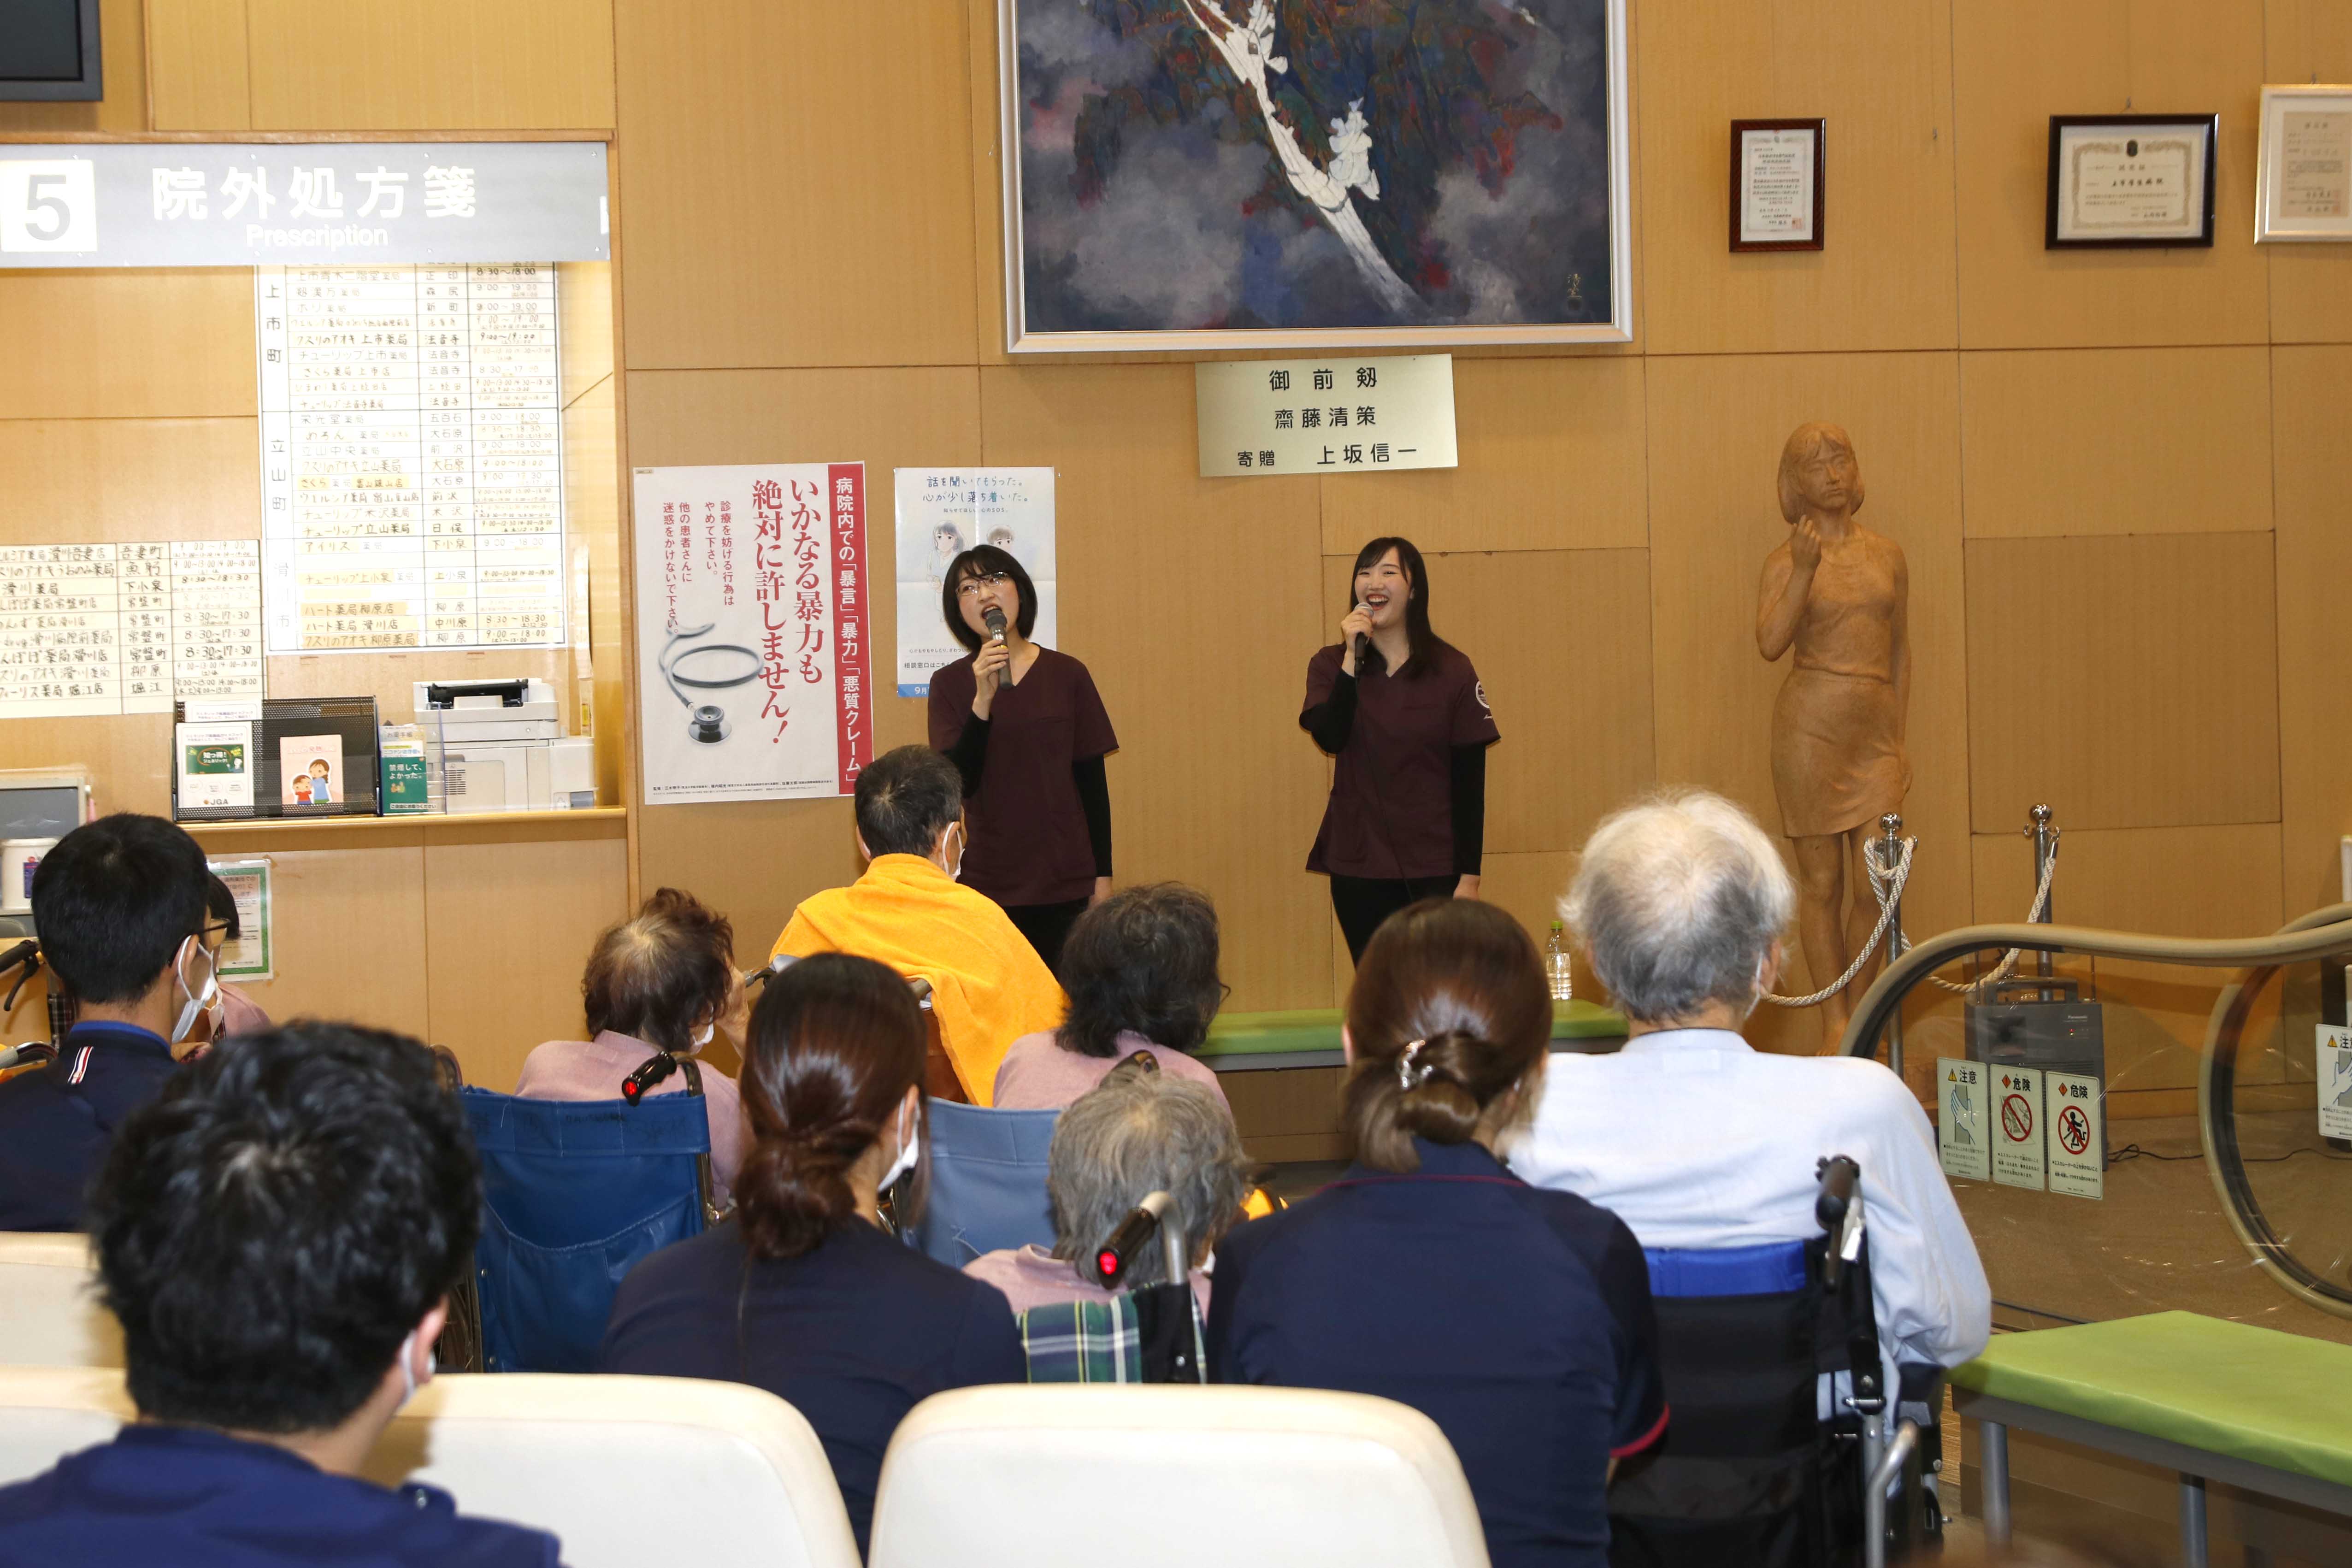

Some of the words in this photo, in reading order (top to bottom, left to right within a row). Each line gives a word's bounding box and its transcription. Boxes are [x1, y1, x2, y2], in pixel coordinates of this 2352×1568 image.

[152, 165, 477, 220] 院外処方箋
[25, 175, 71, 241] 5
[246, 224, 389, 251] Prescription
[265, 283, 283, 363] 上市町
[424, 333, 460, 345] 法音寺
[427, 350, 460, 360] 法音寺
[427, 365, 460, 375] 法音寺
[430, 397, 460, 407] 法音寺
[430, 413, 461, 423] 五百石
[430, 429, 462, 439] 大石原
[430, 444, 463, 454] 前沢
[1238, 450, 1275, 467] 寄贈
[1317, 443, 1417, 465] 上坂信一
[432, 458, 465, 471] 大石原
[270, 439, 288, 511] 立山町
[432, 476, 464, 486] 大石原
[926, 476, 1023, 488] 話を聞いてもらった。
[923, 491, 1029, 504] 心が少し落ち着いた。
[431, 538, 466, 550] 下小泉
[679, 502, 693, 584] 他の患者さんに
[704, 501, 719, 576] やめて下さい。
[122, 544, 164, 560] 吾妻町
[720, 501, 734, 607] 診療を妨げる行為は
[435, 570, 466, 580] 上小泉
[663, 502, 679, 634] 迷惑をかけないで下さい。
[124, 579, 164, 592] 下小泉
[790, 479, 824, 684] いかなる暴力も
[1, 582, 59, 597] 滑川薬局
[435, 601, 465, 613] 柳原
[435, 617, 468, 629] 中川原
[836, 477, 861, 782] 病院内での「暴言」「暴力」「悪質クレーム」
[436, 631, 466, 643] 柳原
[130, 646, 167, 662] 常盤町
[131, 682, 163, 694] 堀江
[1959, 1069, 1977, 1085] 注意
[2013, 1077, 2031, 1092] 危険
[2070, 1084, 2088, 1100] 危険
